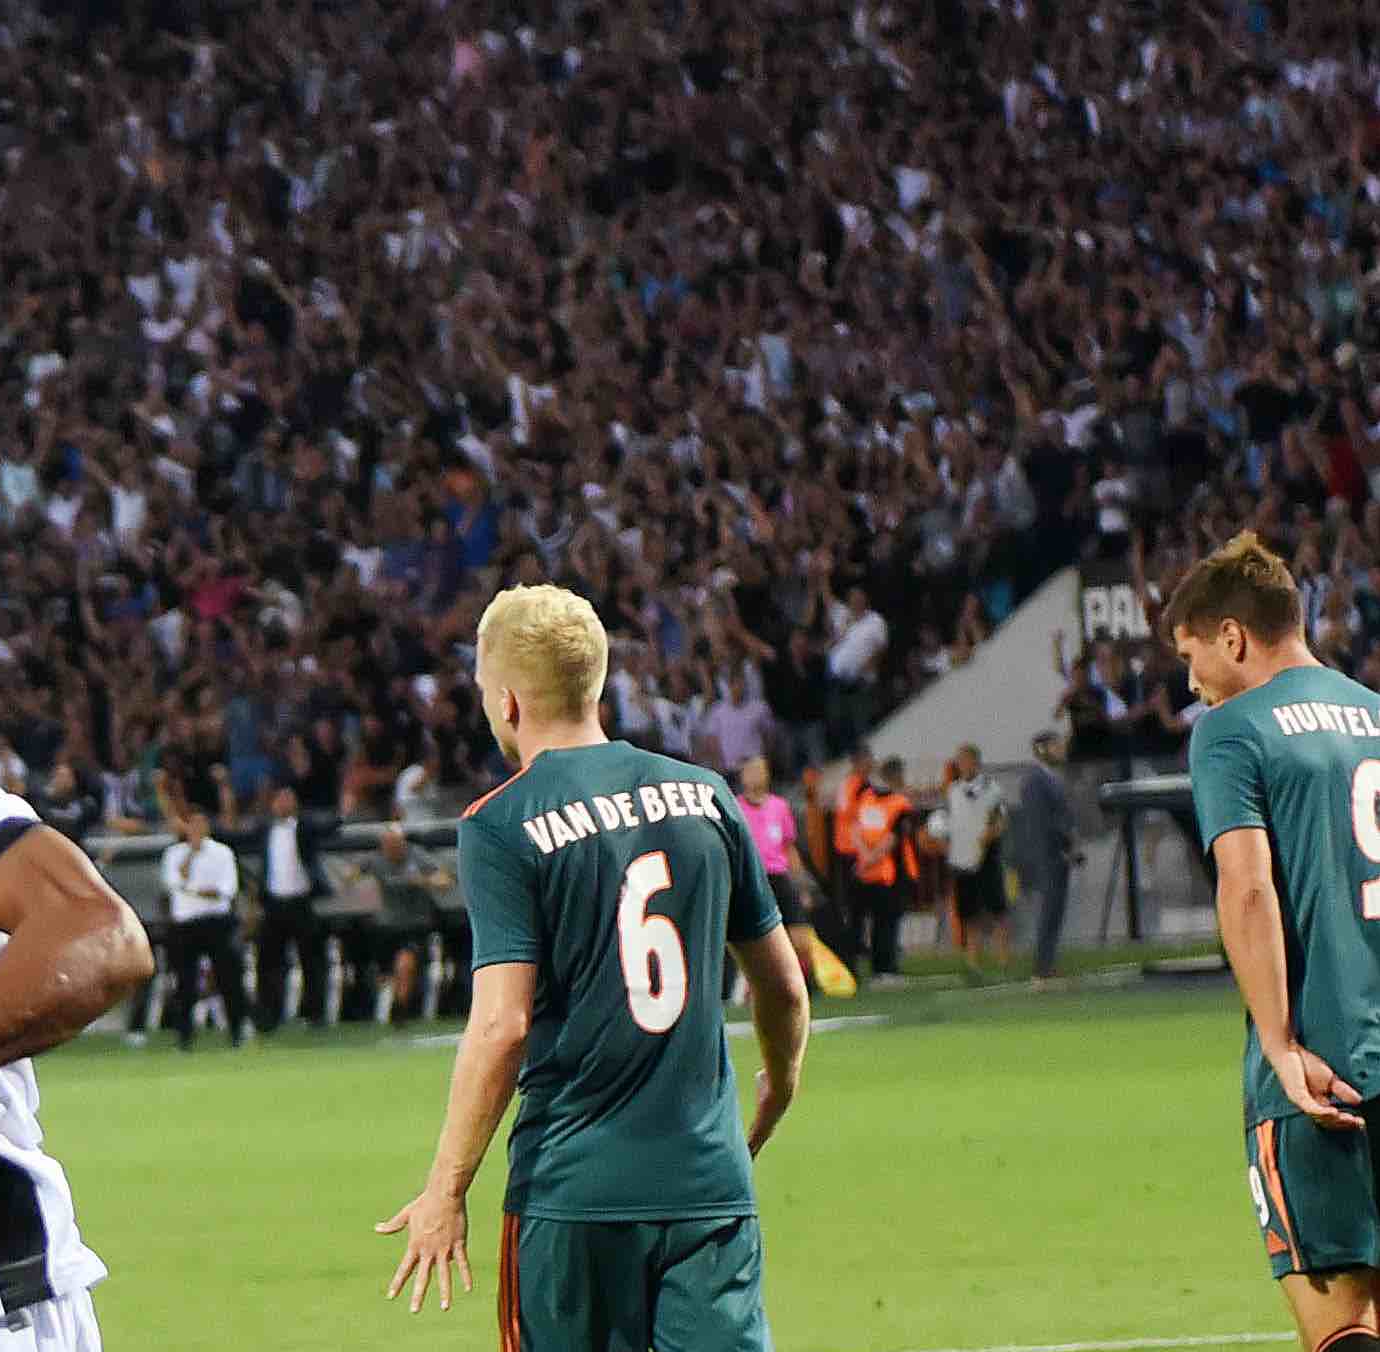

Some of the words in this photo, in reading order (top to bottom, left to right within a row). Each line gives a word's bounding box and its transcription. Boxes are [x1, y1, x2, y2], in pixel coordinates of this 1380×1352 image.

[1271, 701, 1380, 737] HUNTEL
[522, 800, 600, 854] VAN
[592, 791, 640, 831] DE
[639, 781, 722, 823] BEEK
[616, 849, 689, 1035] 6
